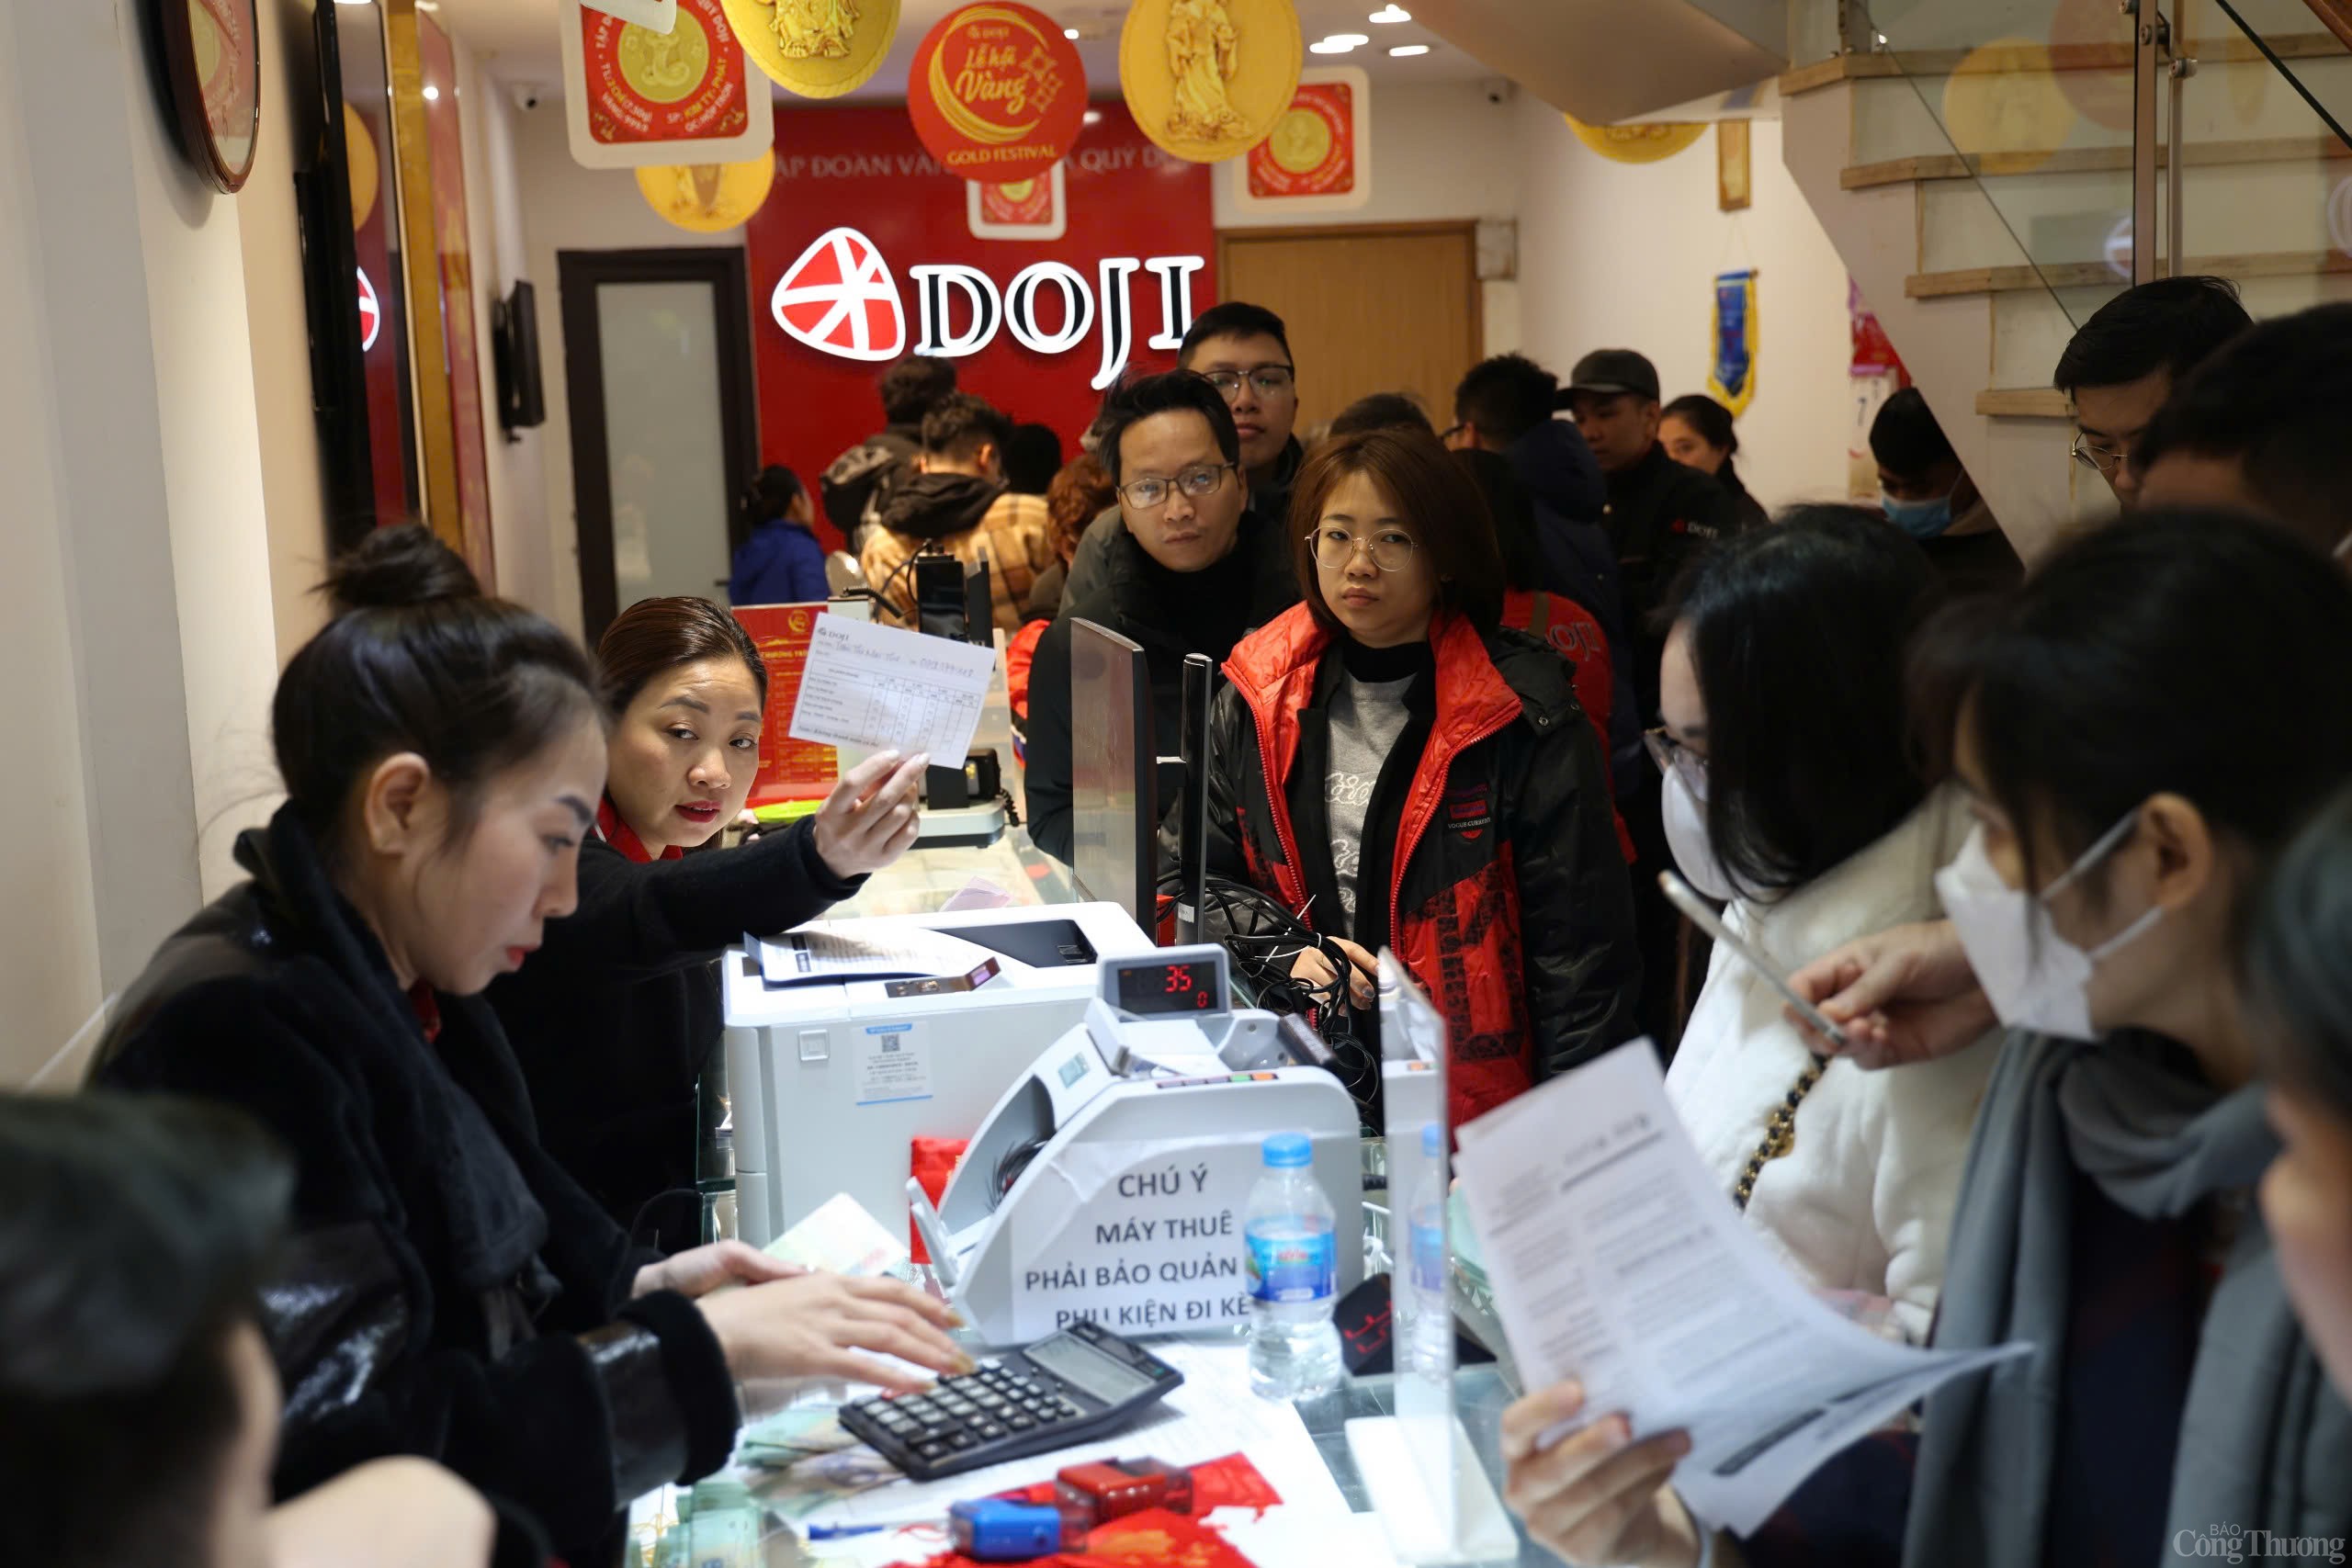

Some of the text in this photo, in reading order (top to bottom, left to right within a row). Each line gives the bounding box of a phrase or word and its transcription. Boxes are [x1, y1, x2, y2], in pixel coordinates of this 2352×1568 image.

[956, 70, 1030, 115] Vàng
[946, 144, 1057, 165] GOLD FESTIVAL
[909, 255, 1205, 390] DOJI
[1544, 622, 1601, 662] OJI
[1164, 964, 1193, 994] 35
[1118, 1162, 1209, 1198] CHÚ Ý
[1095, 1209, 1233, 1245] MÁY THUÊ
[1025, 1251, 1238, 1291] PHẢI BẢO QUẢN
[1119, 1299, 1177, 1329] KIỆN
[1185, 1300, 1212, 1320] ĐI
[1220, 1291, 1250, 1316] KÈ
